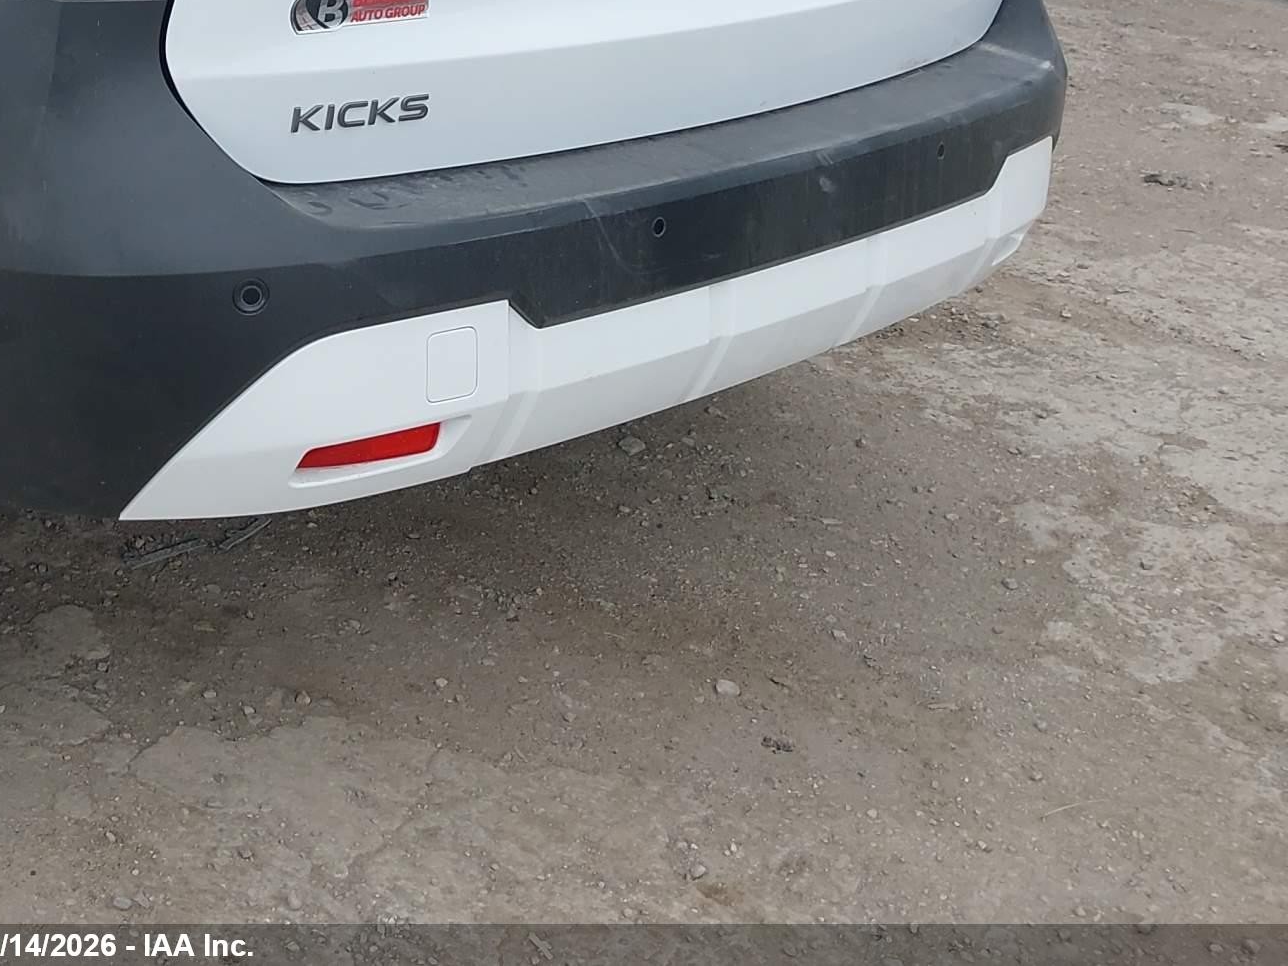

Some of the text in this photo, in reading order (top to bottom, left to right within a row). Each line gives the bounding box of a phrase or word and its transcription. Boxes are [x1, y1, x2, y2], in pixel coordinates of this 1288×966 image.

[350, 4, 426, 22] AUTO GROUP
[290, 93, 430, 133] KICKS
